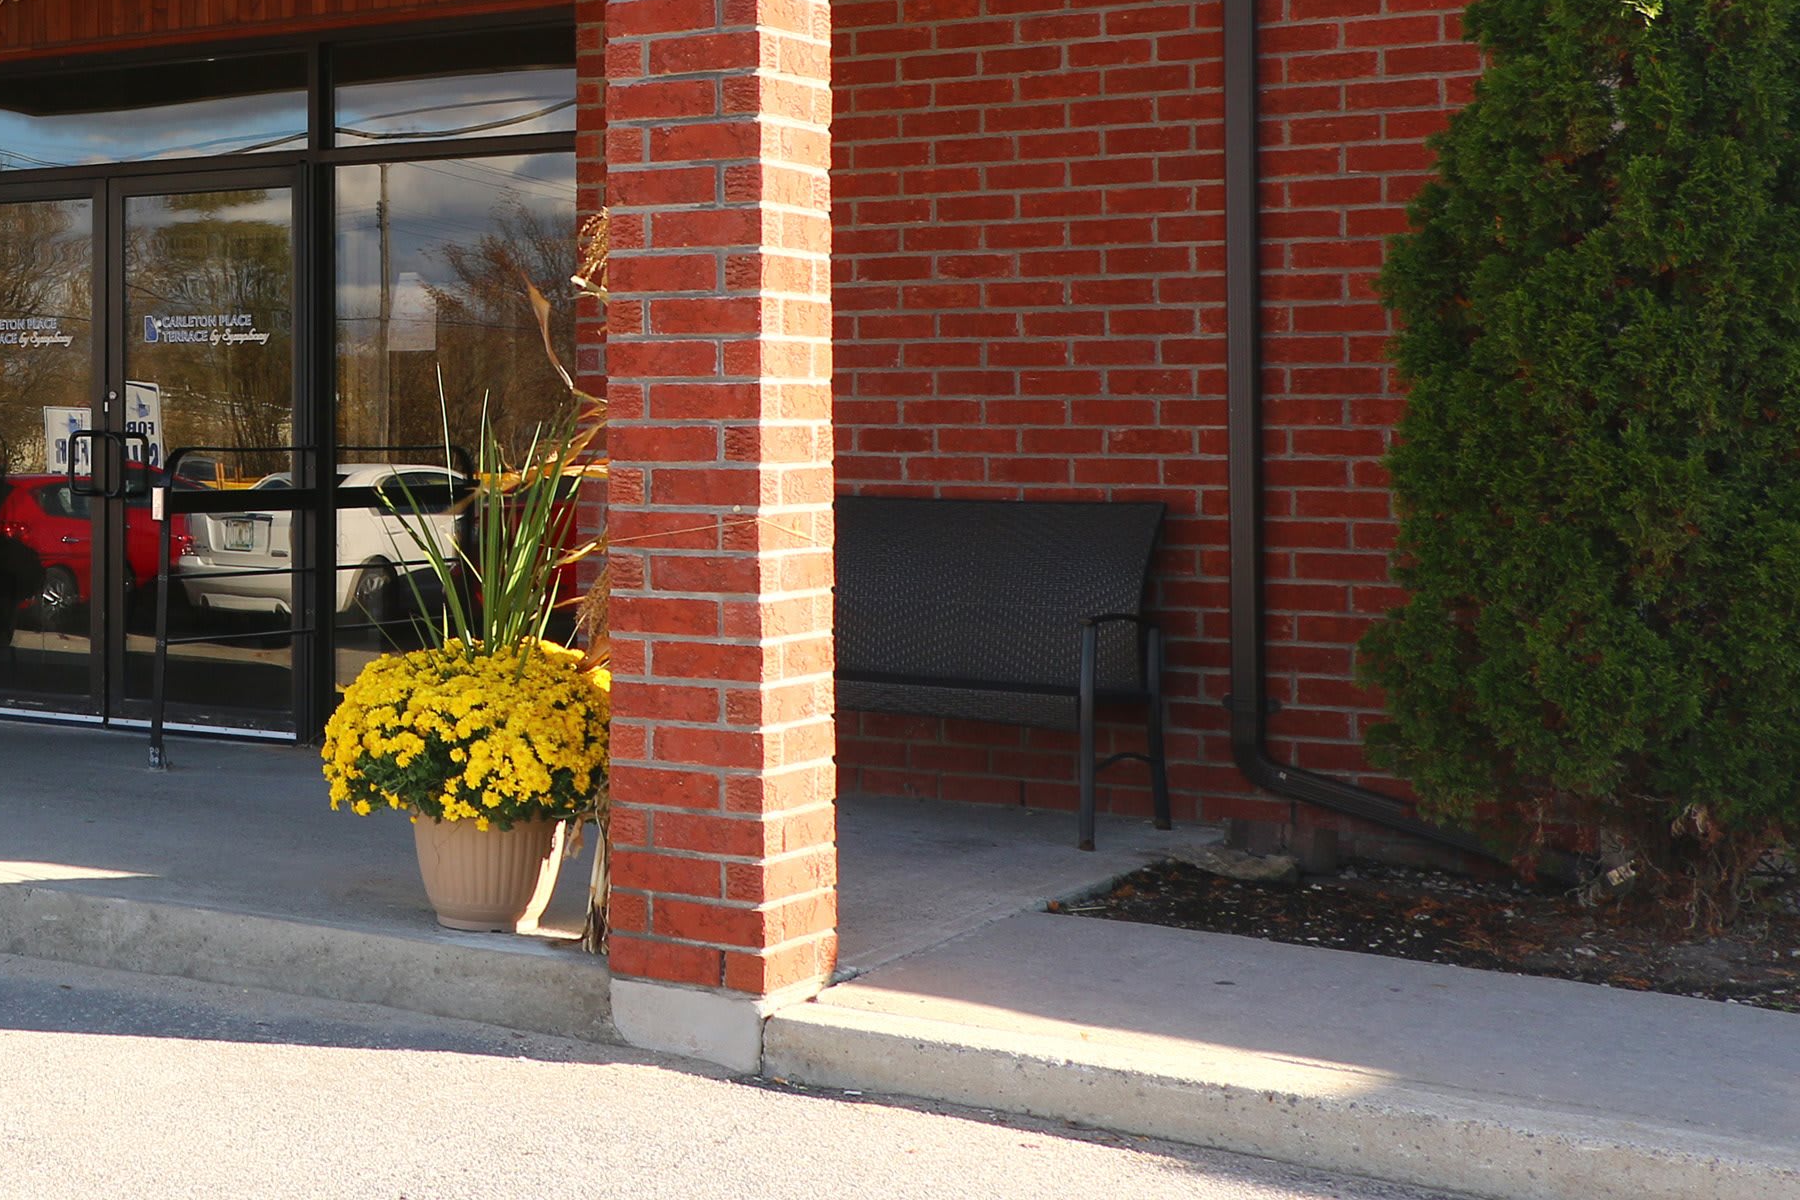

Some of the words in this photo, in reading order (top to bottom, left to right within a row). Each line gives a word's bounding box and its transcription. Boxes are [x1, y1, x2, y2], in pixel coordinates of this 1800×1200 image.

[27, 317, 57, 330] PLACE
[162, 314, 217, 328] CARLETON
[219, 313, 252, 327] PLACE
[162, 330, 208, 343] TERRACE
[222, 328, 270, 346] Symphony
